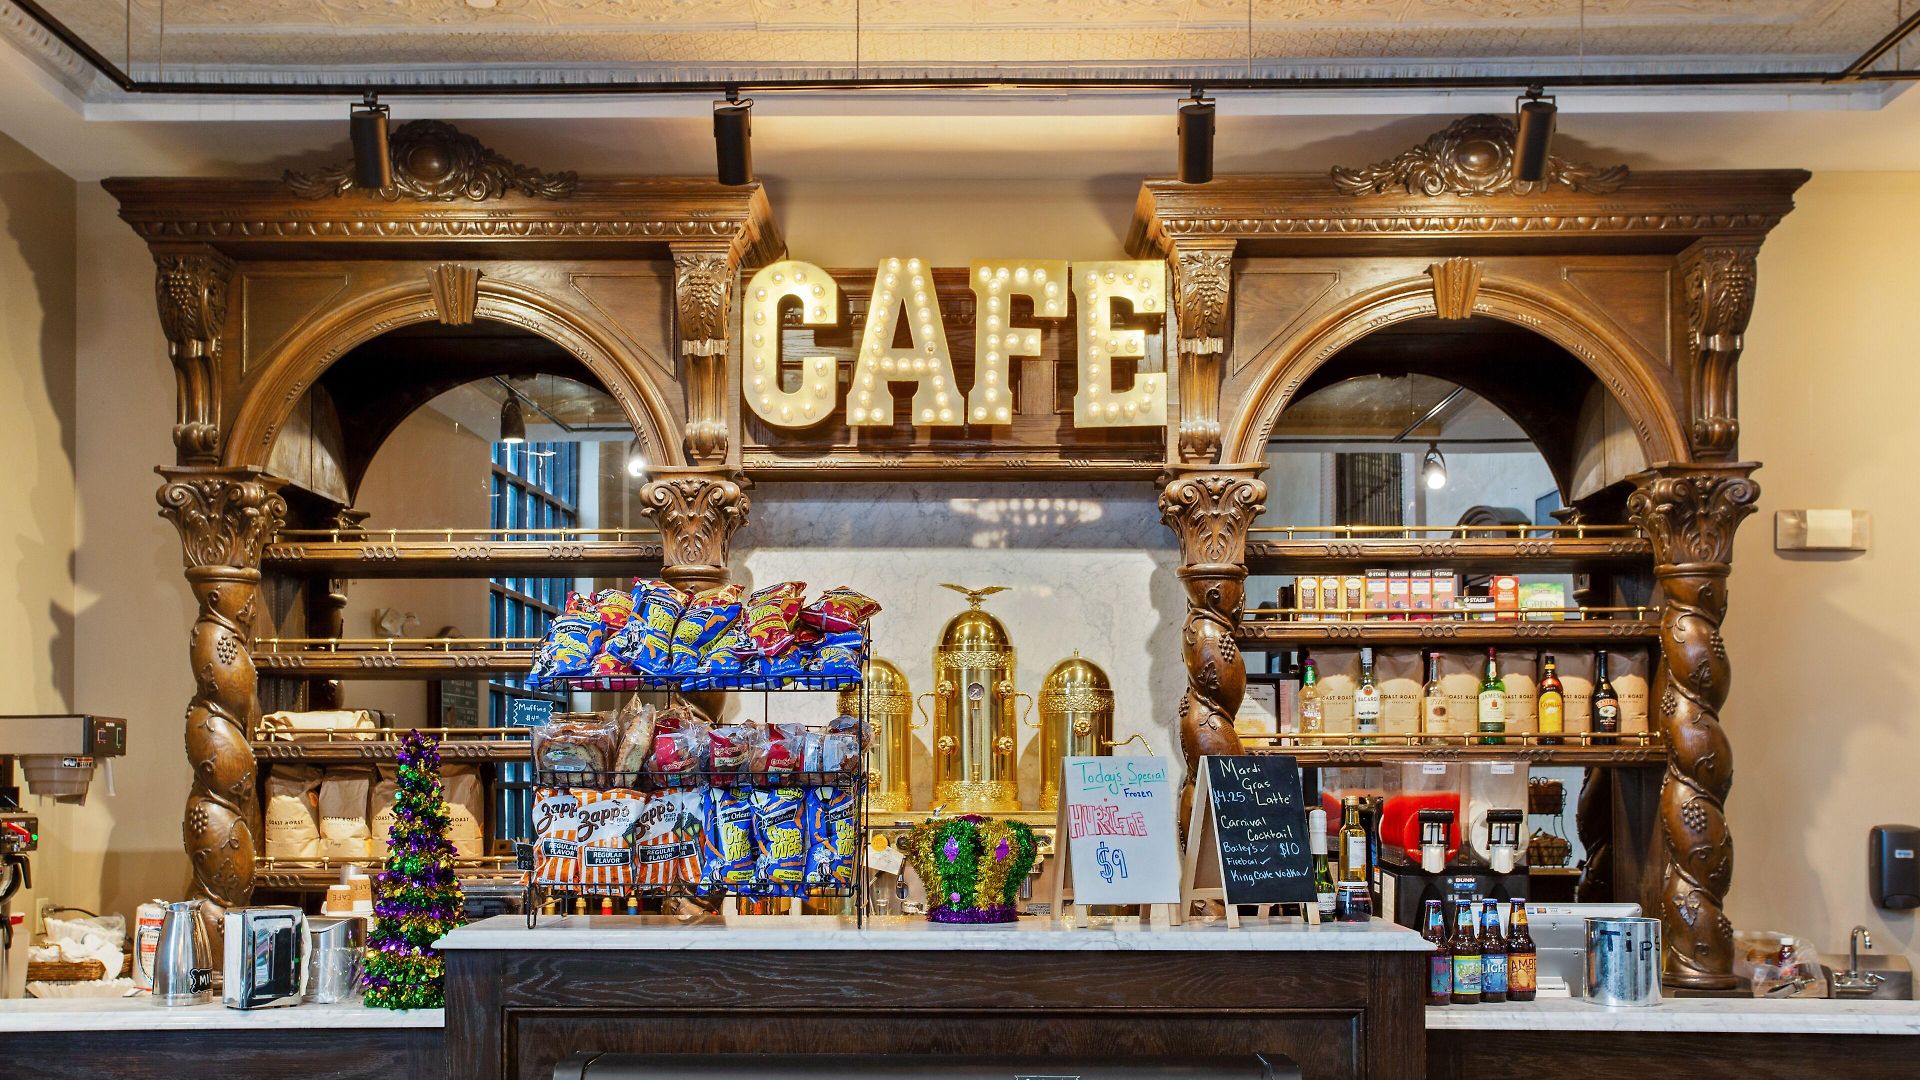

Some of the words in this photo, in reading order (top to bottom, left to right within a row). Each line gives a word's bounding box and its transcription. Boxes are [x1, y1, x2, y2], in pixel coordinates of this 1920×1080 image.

[743, 258, 1168, 428] CAFE
[518, 703, 547, 713] Muffins
[1220, 758, 1261, 780] Mardi
[1072, 761, 1121, 795] Today's
[1127, 762, 1166, 787] Special
[1242, 777, 1271, 795] Gras
[1123, 788, 1153, 798] Frozen
[1213, 788, 1246, 810] $4.25
[536, 802, 578, 835] Zapp
[731, 811, 750, 820] Orlean
[1220, 815, 1267, 829] Carnival
[1247, 825, 1293, 841] Cocktail
[550, 848, 576, 857] FLAVOR
[647, 847, 675, 856] REGULAR
[649, 853, 673, 862] FLAVOR
[1222, 842, 1260, 856] Bailey's
[1280, 842, 1300, 858] $10
[595, 857, 621, 865] FLAVOR
[1096, 841, 1128, 884] $9
[1230, 869, 1255, 887] King
[1599, 929, 1661, 961] Tips
